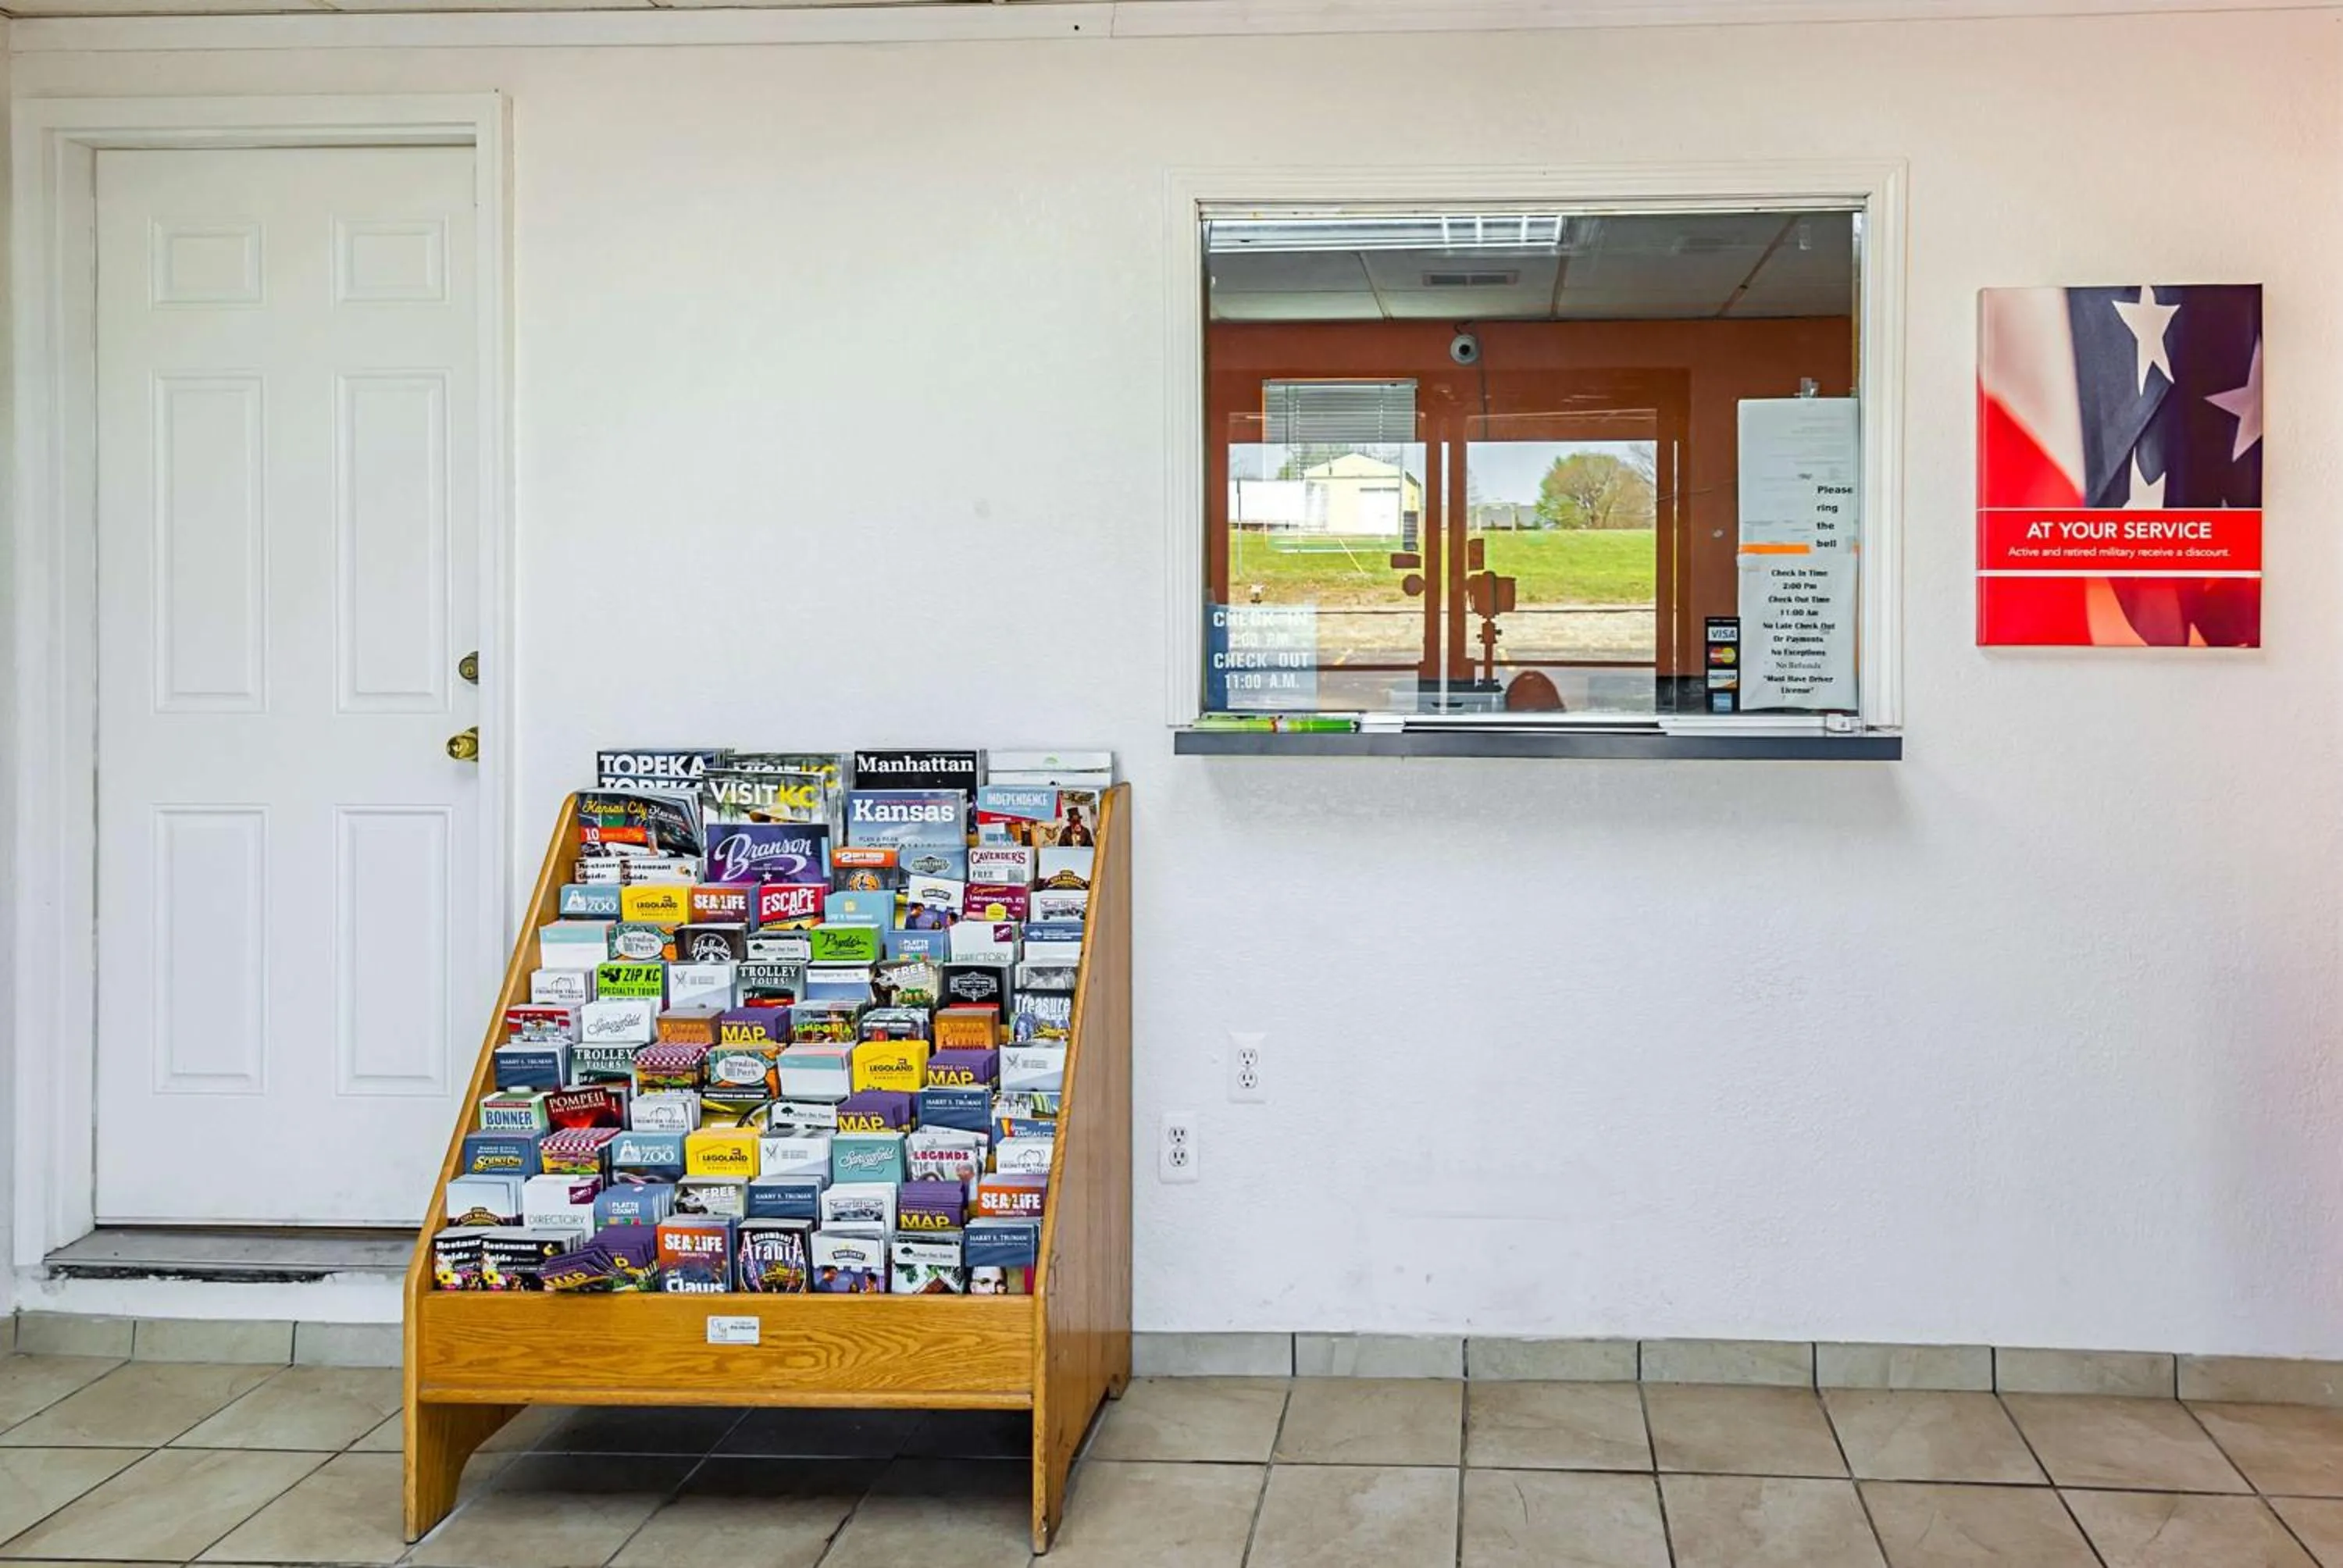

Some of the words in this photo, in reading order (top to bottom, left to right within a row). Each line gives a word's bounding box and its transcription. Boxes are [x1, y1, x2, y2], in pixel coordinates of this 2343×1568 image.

[1817, 485, 1853, 494] Please
[1816, 504, 1838, 514] ring
[1816, 522, 1835, 530] the
[2027, 522, 2053, 539] AT
[2059, 522, 2118, 540] YOUR
[2124, 522, 2213, 540] SERVICE
[1816, 539, 1838, 548] bell
[2008, 547, 2040, 557] Active
[2042, 547, 2062, 557] and
[2065, 547, 2097, 557] retired
[2099, 547, 2135, 560] military
[2138, 547, 2171, 557] receive
[2186, 547, 2231, 557] discount.
[1771, 569, 1796, 578] Check
[1798, 569, 1807, 578] In
[1810, 569, 1828, 578] Time
[1768, 596, 1792, 604] Check
[1811, 596, 1831, 604] Time
[1213, 611, 1273, 628] CHECK
[1711, 629, 1736, 639] VISA
[1214, 653, 1267, 669] CHECK
[1278, 653, 1310, 668] OUT
[1225, 674, 1261, 690] 11:00
[1269, 674, 1300, 689] A.M.
[600, 754, 707, 777] TOPEKA
[857, 754, 975, 773] Manhattan
[986, 793, 1049, 807] INDEPENDENCE
[582, 800, 624, 814] Kansas
[627, 800, 648, 821] City
[852, 799, 956, 823] Kansas
[584, 828, 600, 841] 10
[714, 832, 813, 882] Branson
[971, 850, 1026, 864] CAVENDER'S
[587, 901, 618, 913] ZOO
[694, 894, 716, 910] SEA
[720, 895, 747, 910] LIFE
[761, 888, 816, 916] ESCAPE
[955, 952, 1008, 963] DIRECTORY
[622, 968, 643, 982] ZIP
[644, 968, 661, 982] KC
[738, 965, 798, 977] TROLLEY
[894, 963, 927, 977] FREE
[751, 977, 788, 985] TOURS
[600, 986, 636, 996] SPECIALTY
[638, 986, 661, 996] TOURS
[1014, 992, 1072, 1013] Treasure
[721, 1026, 767, 1042] MAP
[797, 1024, 852, 1034] EMPORIA
[574, 1048, 635, 1060] TROLLEY
[585, 1060, 621, 1069] TOURS
[928, 1071, 974, 1085] MAP
[549, 1092, 605, 1108] POMPEII
[485, 1111, 533, 1126] BONNER
[838, 1116, 885, 1131] MAP
[642, 1149, 676, 1164] ZOO
[914, 1150, 969, 1161] LEGENDS
[702, 1185, 737, 1198] FREE
[981, 1192, 1007, 1209] SEA
[1011, 1193, 1041, 1209] LIFE
[527, 1214, 586, 1226] DIRECTORY
[900, 1214, 950, 1228] MAP
[482, 1241, 538, 1251] Restaurant
[664, 1233, 690, 1250] SEA
[694, 1236, 723, 1252] LIFE
